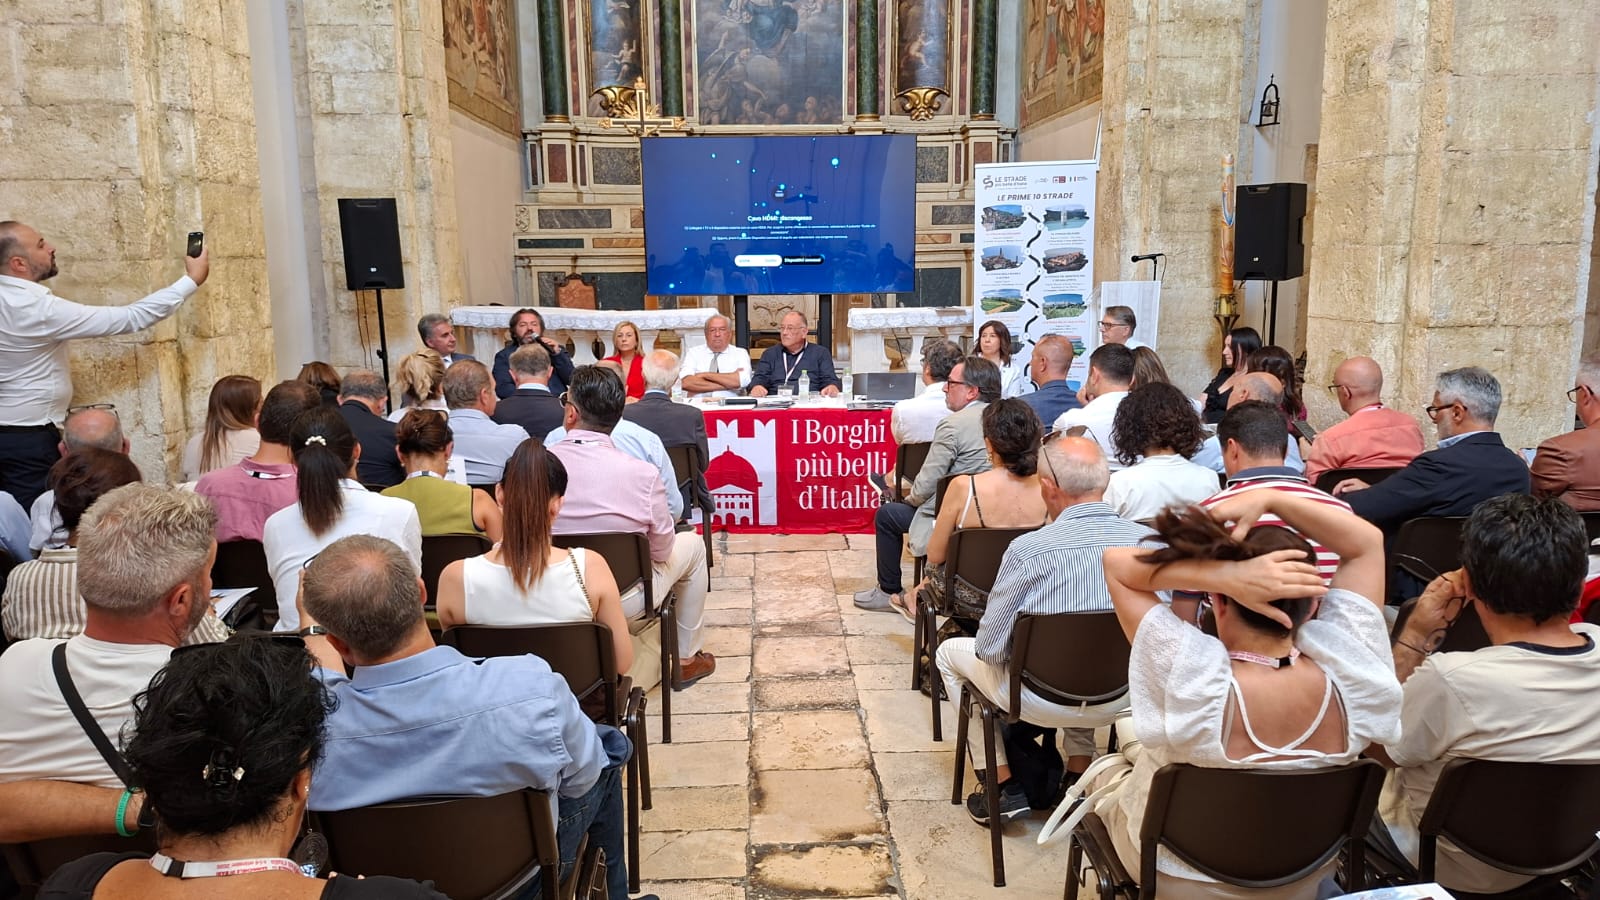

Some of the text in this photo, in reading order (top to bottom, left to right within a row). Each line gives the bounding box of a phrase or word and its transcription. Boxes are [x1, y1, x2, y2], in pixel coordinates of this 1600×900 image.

[1007, 193, 1031, 201] PRIME
[1043, 192, 1074, 200] STRADE
[791, 418, 886, 450] I Borghi
[795, 451, 888, 482] più belli
[799, 484, 882, 510] d'Italia
